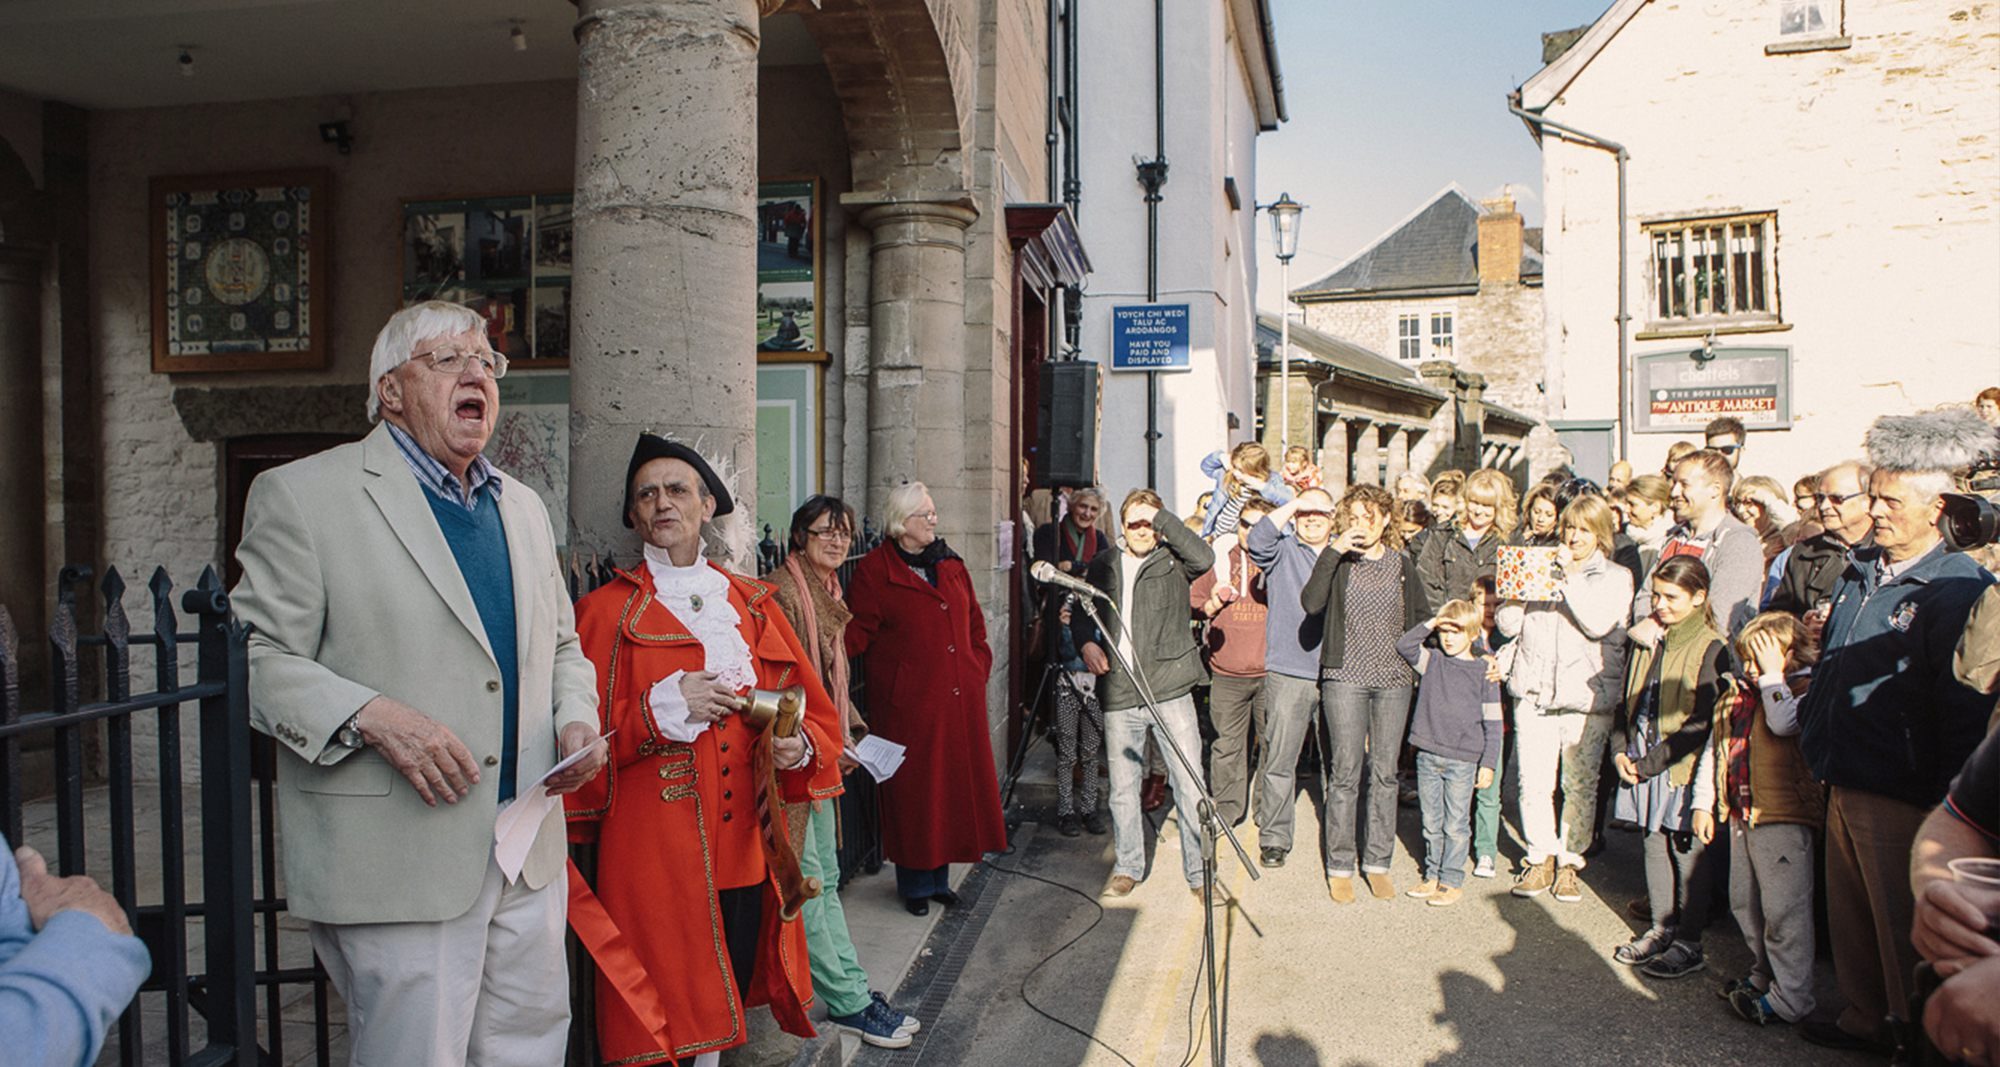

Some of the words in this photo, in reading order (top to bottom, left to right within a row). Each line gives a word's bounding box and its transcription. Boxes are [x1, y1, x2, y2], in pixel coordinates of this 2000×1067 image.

[1724, 388, 1767, 396] GALLERY
[1669, 400, 1721, 413] ANTIQUE
[1722, 398, 1774, 411] MARKET
[1232, 612, 1264, 621] STATES
